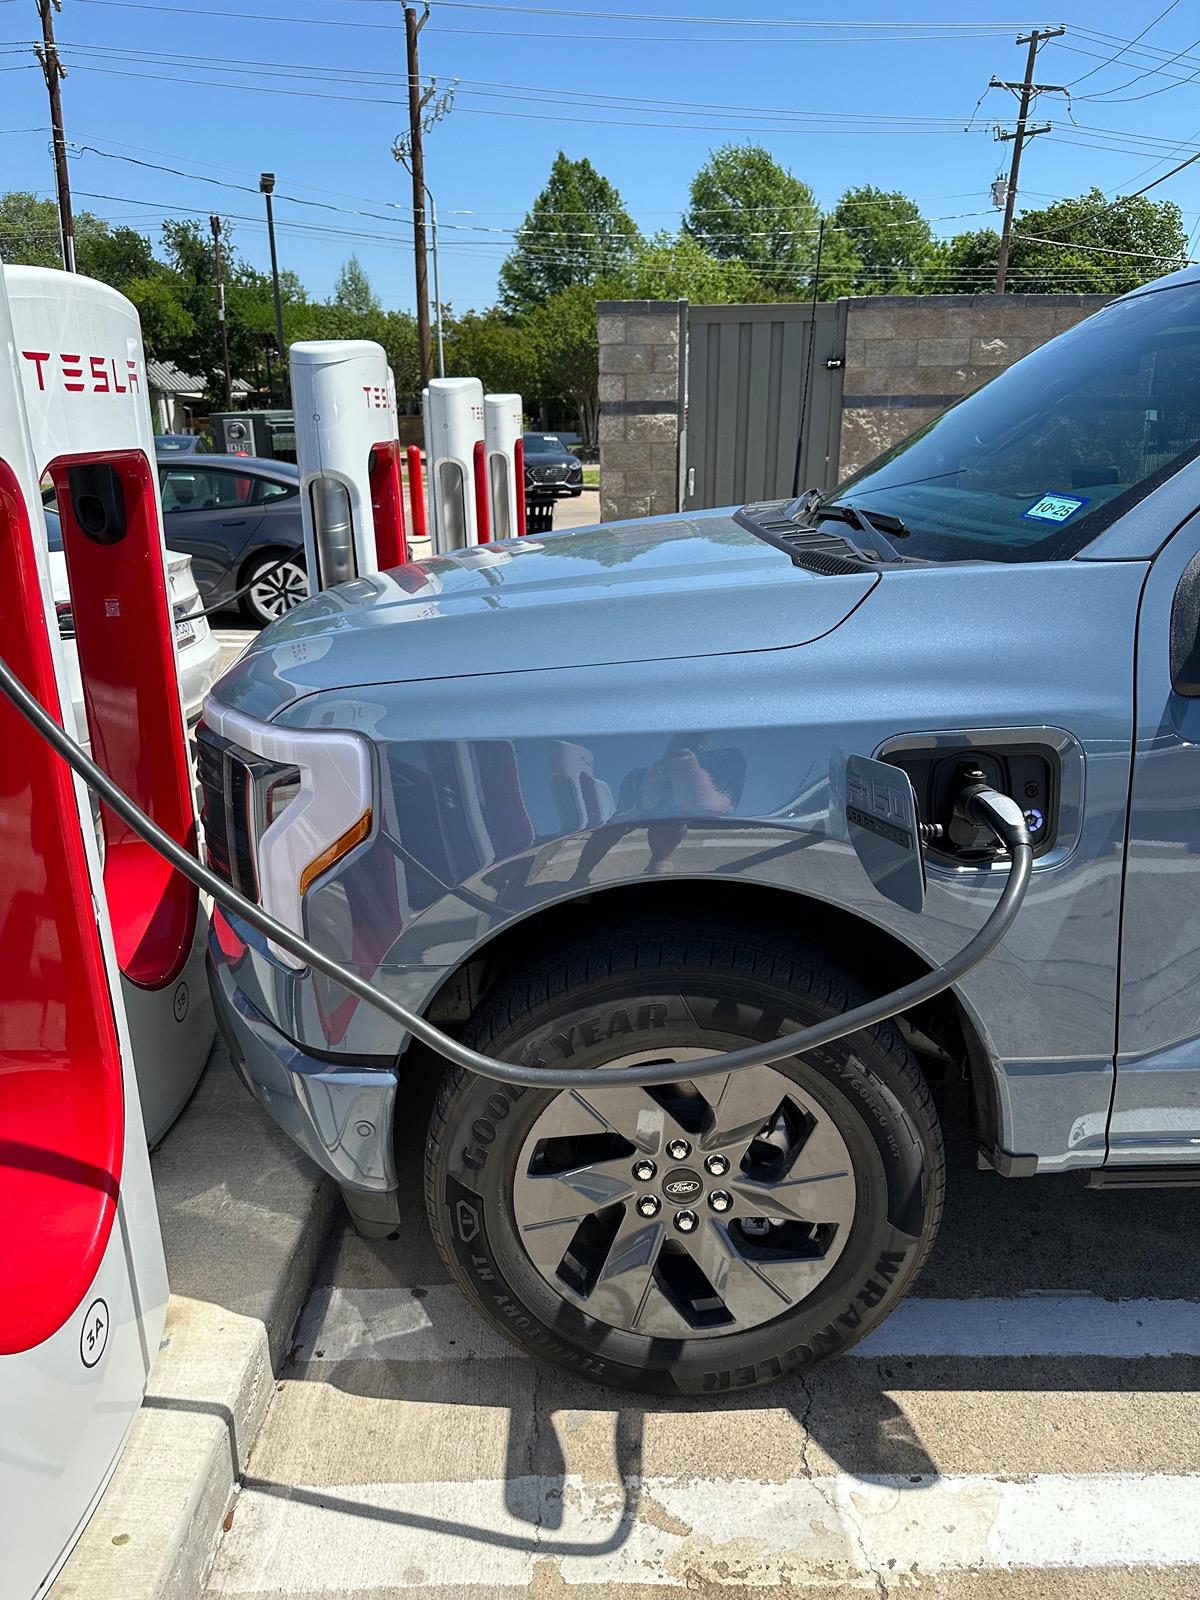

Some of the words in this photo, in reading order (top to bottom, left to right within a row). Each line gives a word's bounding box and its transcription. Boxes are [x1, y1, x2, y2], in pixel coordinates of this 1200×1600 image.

[21, 351, 140, 394] TESLA
[363, 386, 390, 409] TES
[471, 1254, 496, 1281] HT
[86, 1317, 104, 1351] 3A
[703, 1251, 907, 1392] WRANGLER
